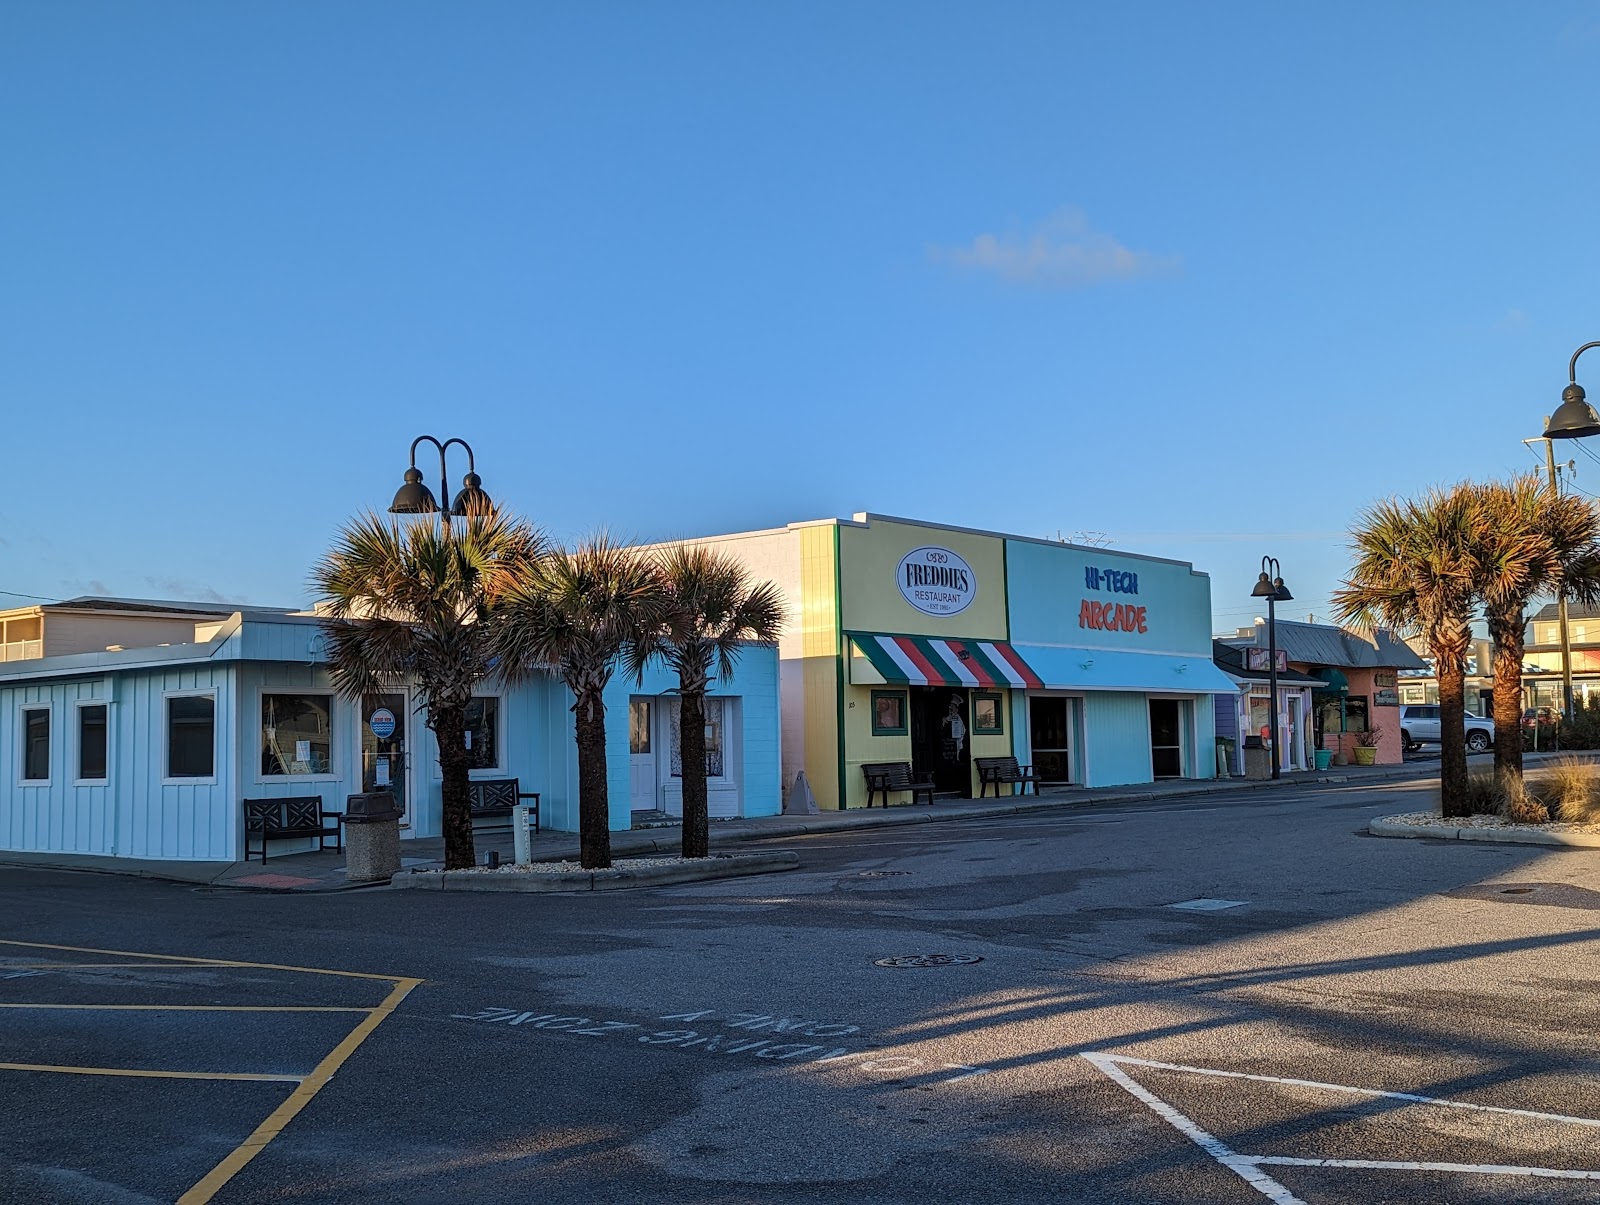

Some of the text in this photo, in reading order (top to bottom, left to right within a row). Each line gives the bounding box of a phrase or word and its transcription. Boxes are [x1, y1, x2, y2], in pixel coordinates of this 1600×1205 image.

[905, 563, 968, 593] FREDDIES
[1085, 566, 1138, 594] HI-TECH
[914, 590, 961, 603] RESTAURANT
[1078, 599, 1148, 634] ARCADE
[450, 1007, 641, 1036] ZONE
[658, 1009, 860, 1038] ONLY
